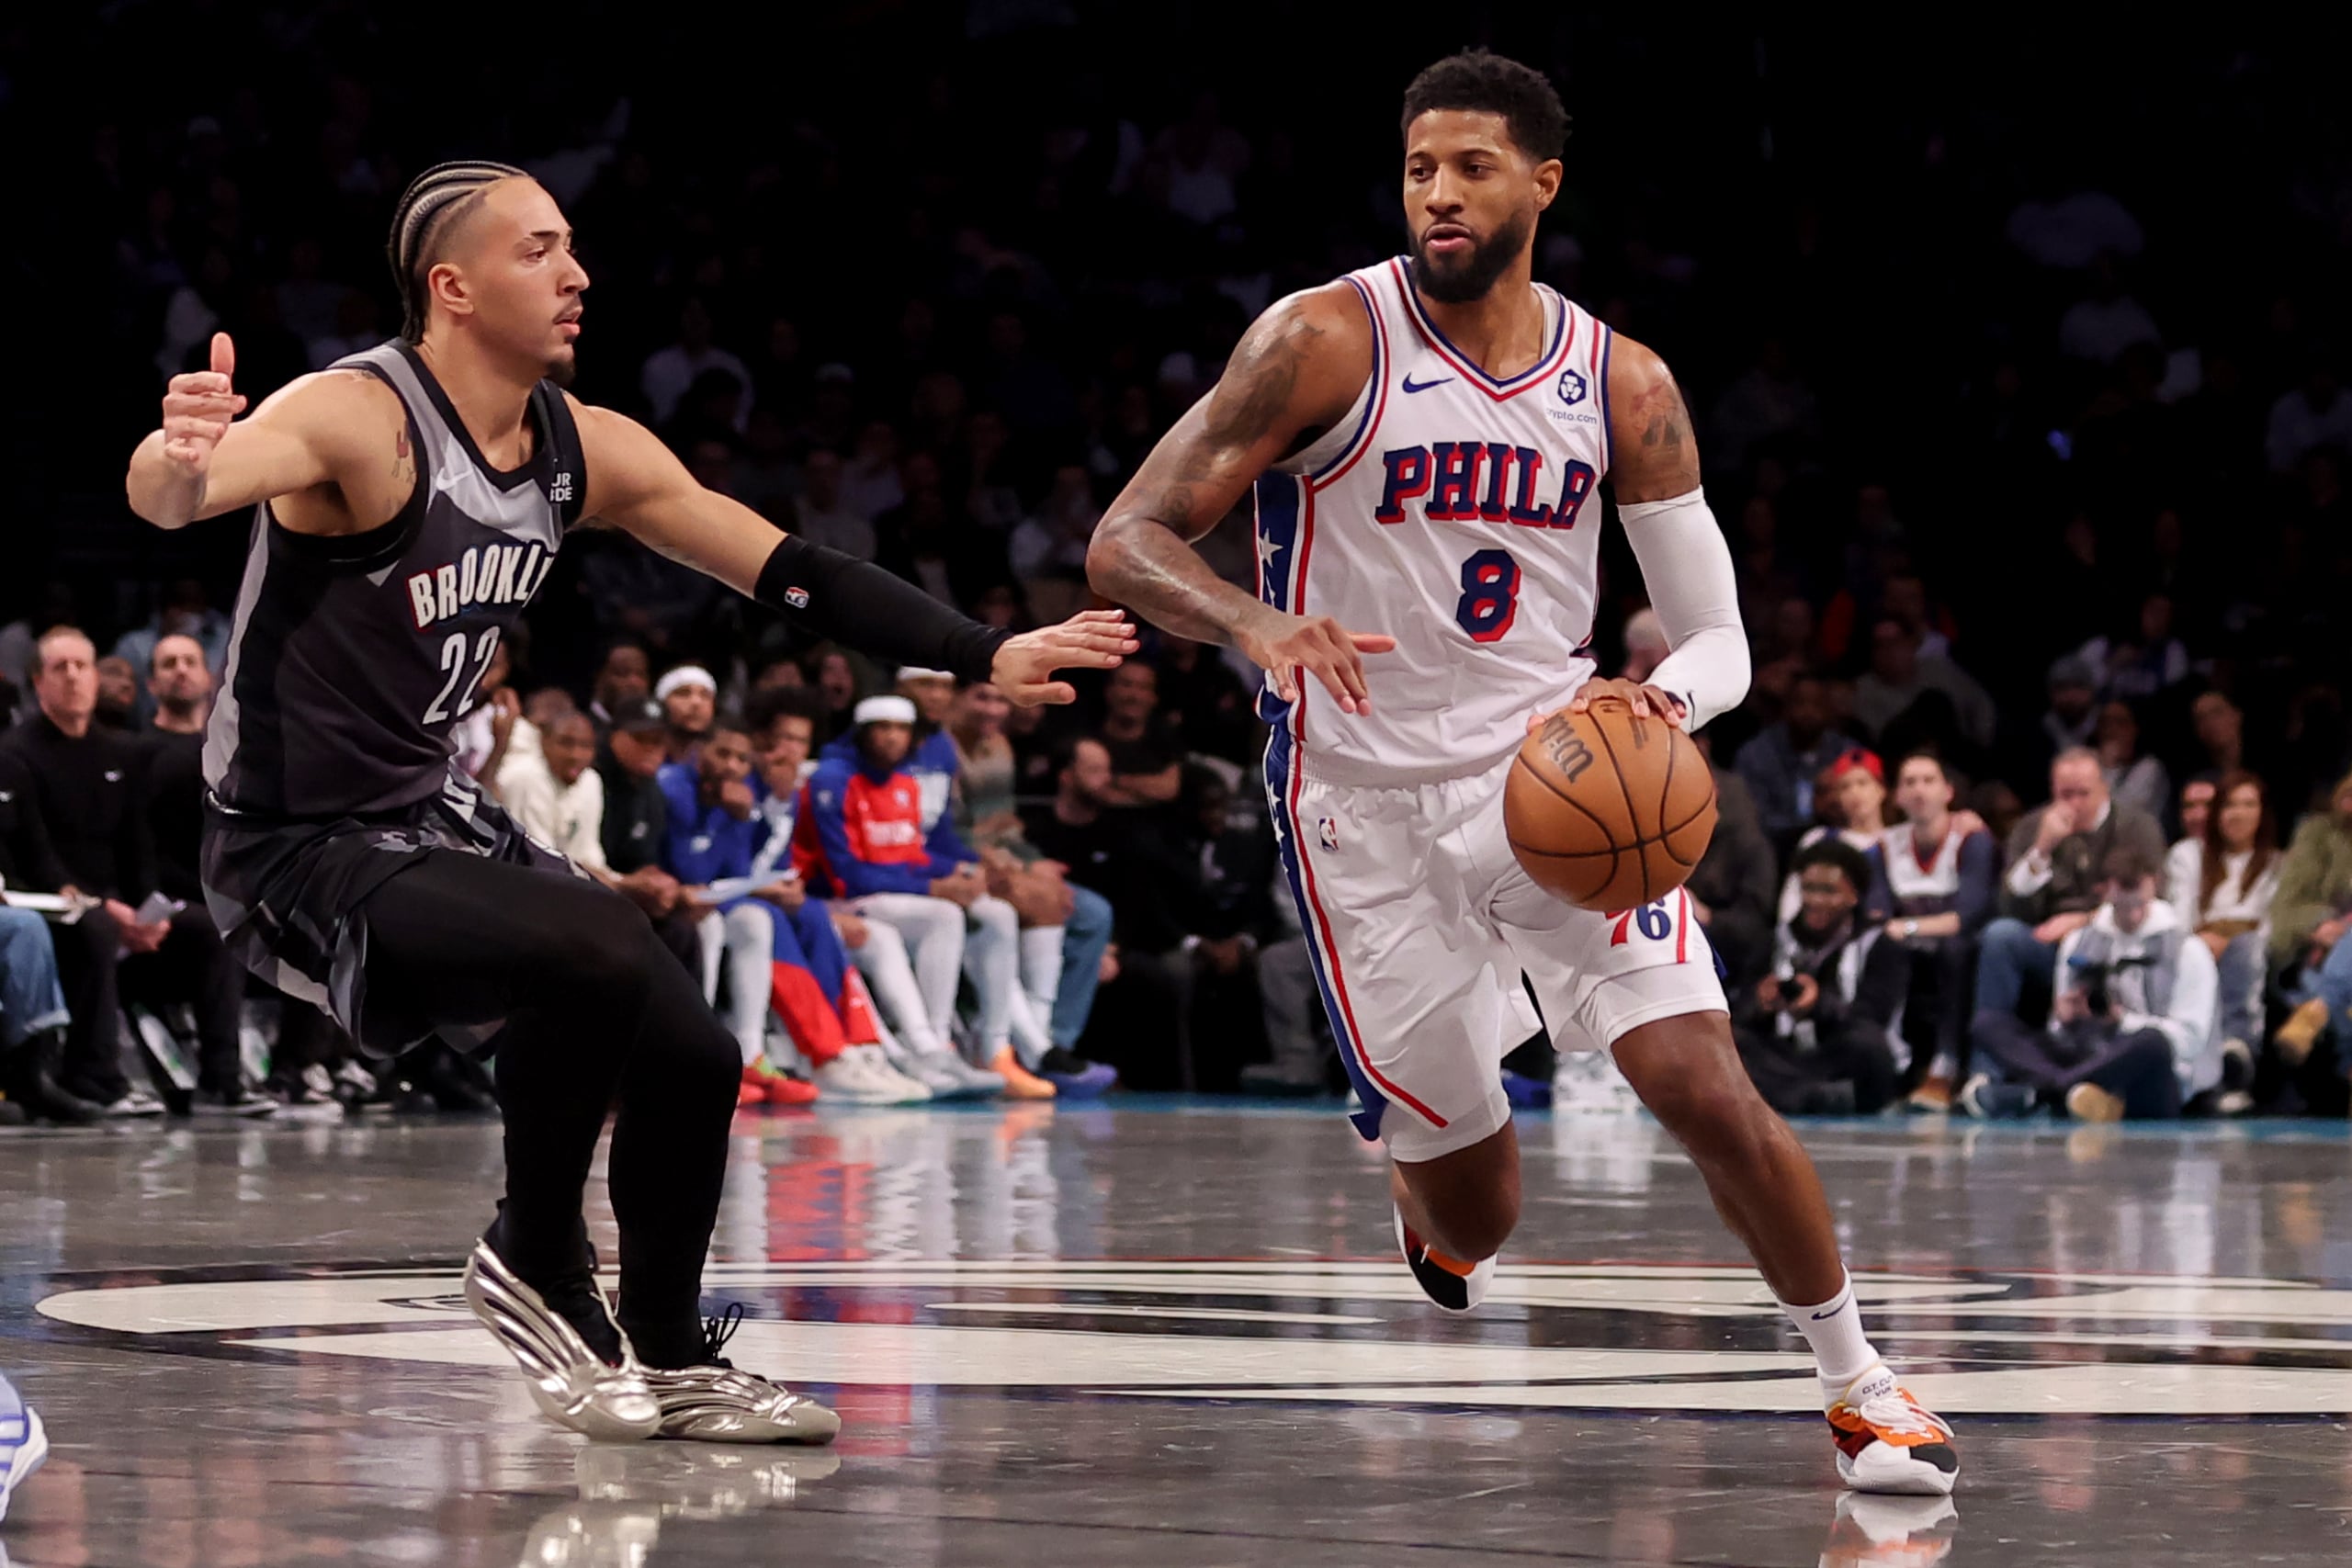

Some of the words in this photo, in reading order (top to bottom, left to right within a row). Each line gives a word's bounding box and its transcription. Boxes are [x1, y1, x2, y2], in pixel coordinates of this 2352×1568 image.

[1546, 407, 1597, 424] rypto.com
[1375, 441, 1596, 530] PHILA
[1456, 549, 1521, 643] 8
[423, 626, 501, 725] 22
